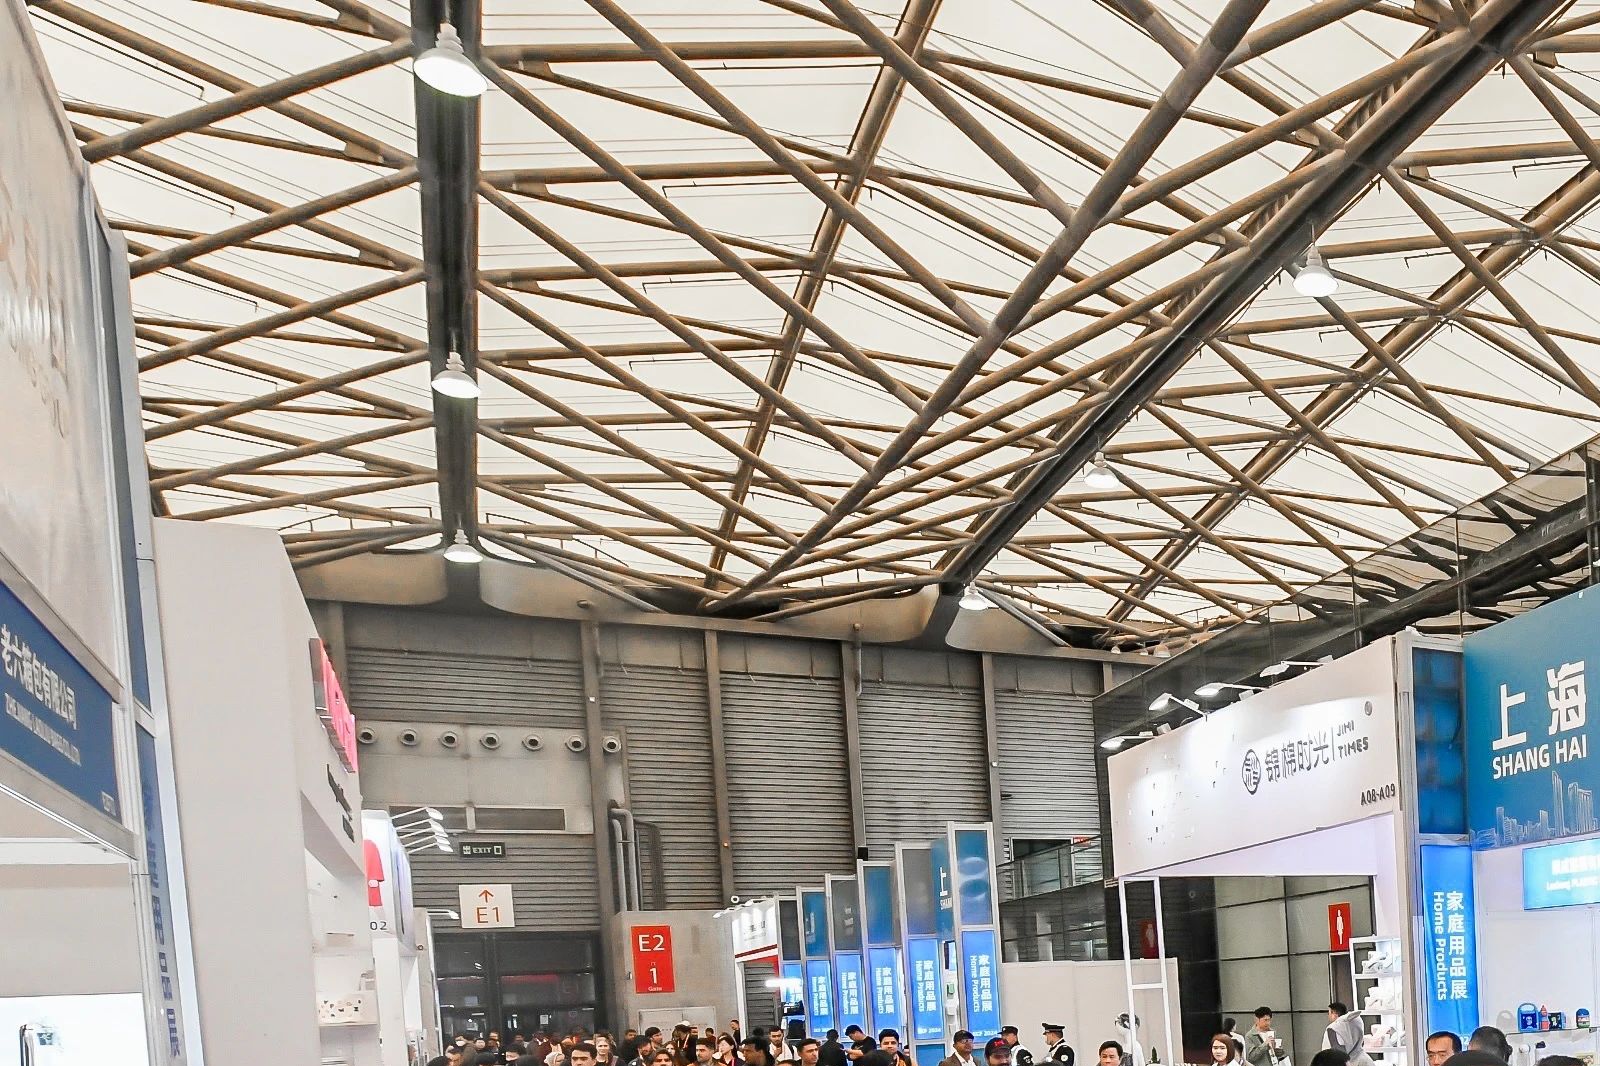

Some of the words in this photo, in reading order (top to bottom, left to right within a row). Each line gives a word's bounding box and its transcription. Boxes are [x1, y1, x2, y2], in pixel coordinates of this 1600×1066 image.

[1492, 660, 1588, 751] 上海
[1337, 736, 1369, 760] TIMES
[1492, 743, 1550, 780] SHANG
[1555, 733, 1588, 765] HAI
[476, 905, 501, 924] E1
[1433, 890, 1445, 936] Home
[638, 934, 665, 952] E2
[1445, 890, 1469, 1001] 家庭用品展
[649, 967, 658, 984] 1
[1435, 937, 1448, 1001] Products
